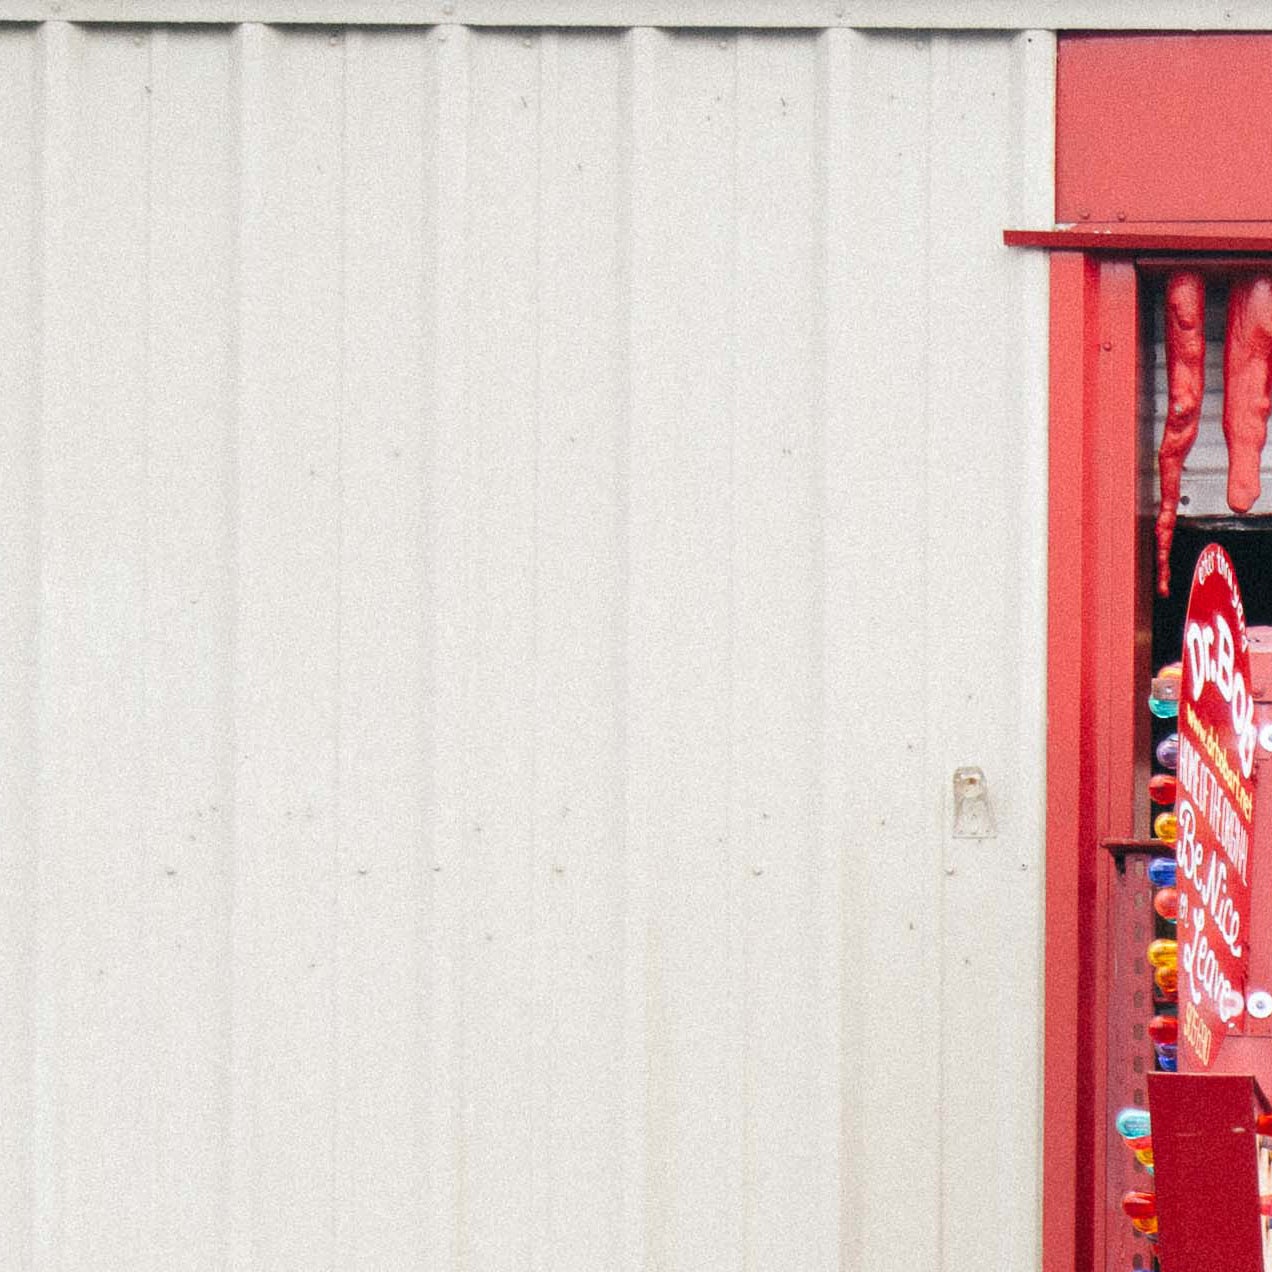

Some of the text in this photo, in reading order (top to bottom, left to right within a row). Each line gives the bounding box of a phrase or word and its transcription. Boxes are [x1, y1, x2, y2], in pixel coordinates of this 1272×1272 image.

[1179, 732, 1201, 807] HOME
[1208, 772, 1224, 842] THE
[1177, 800, 1242, 959] Be Nice
